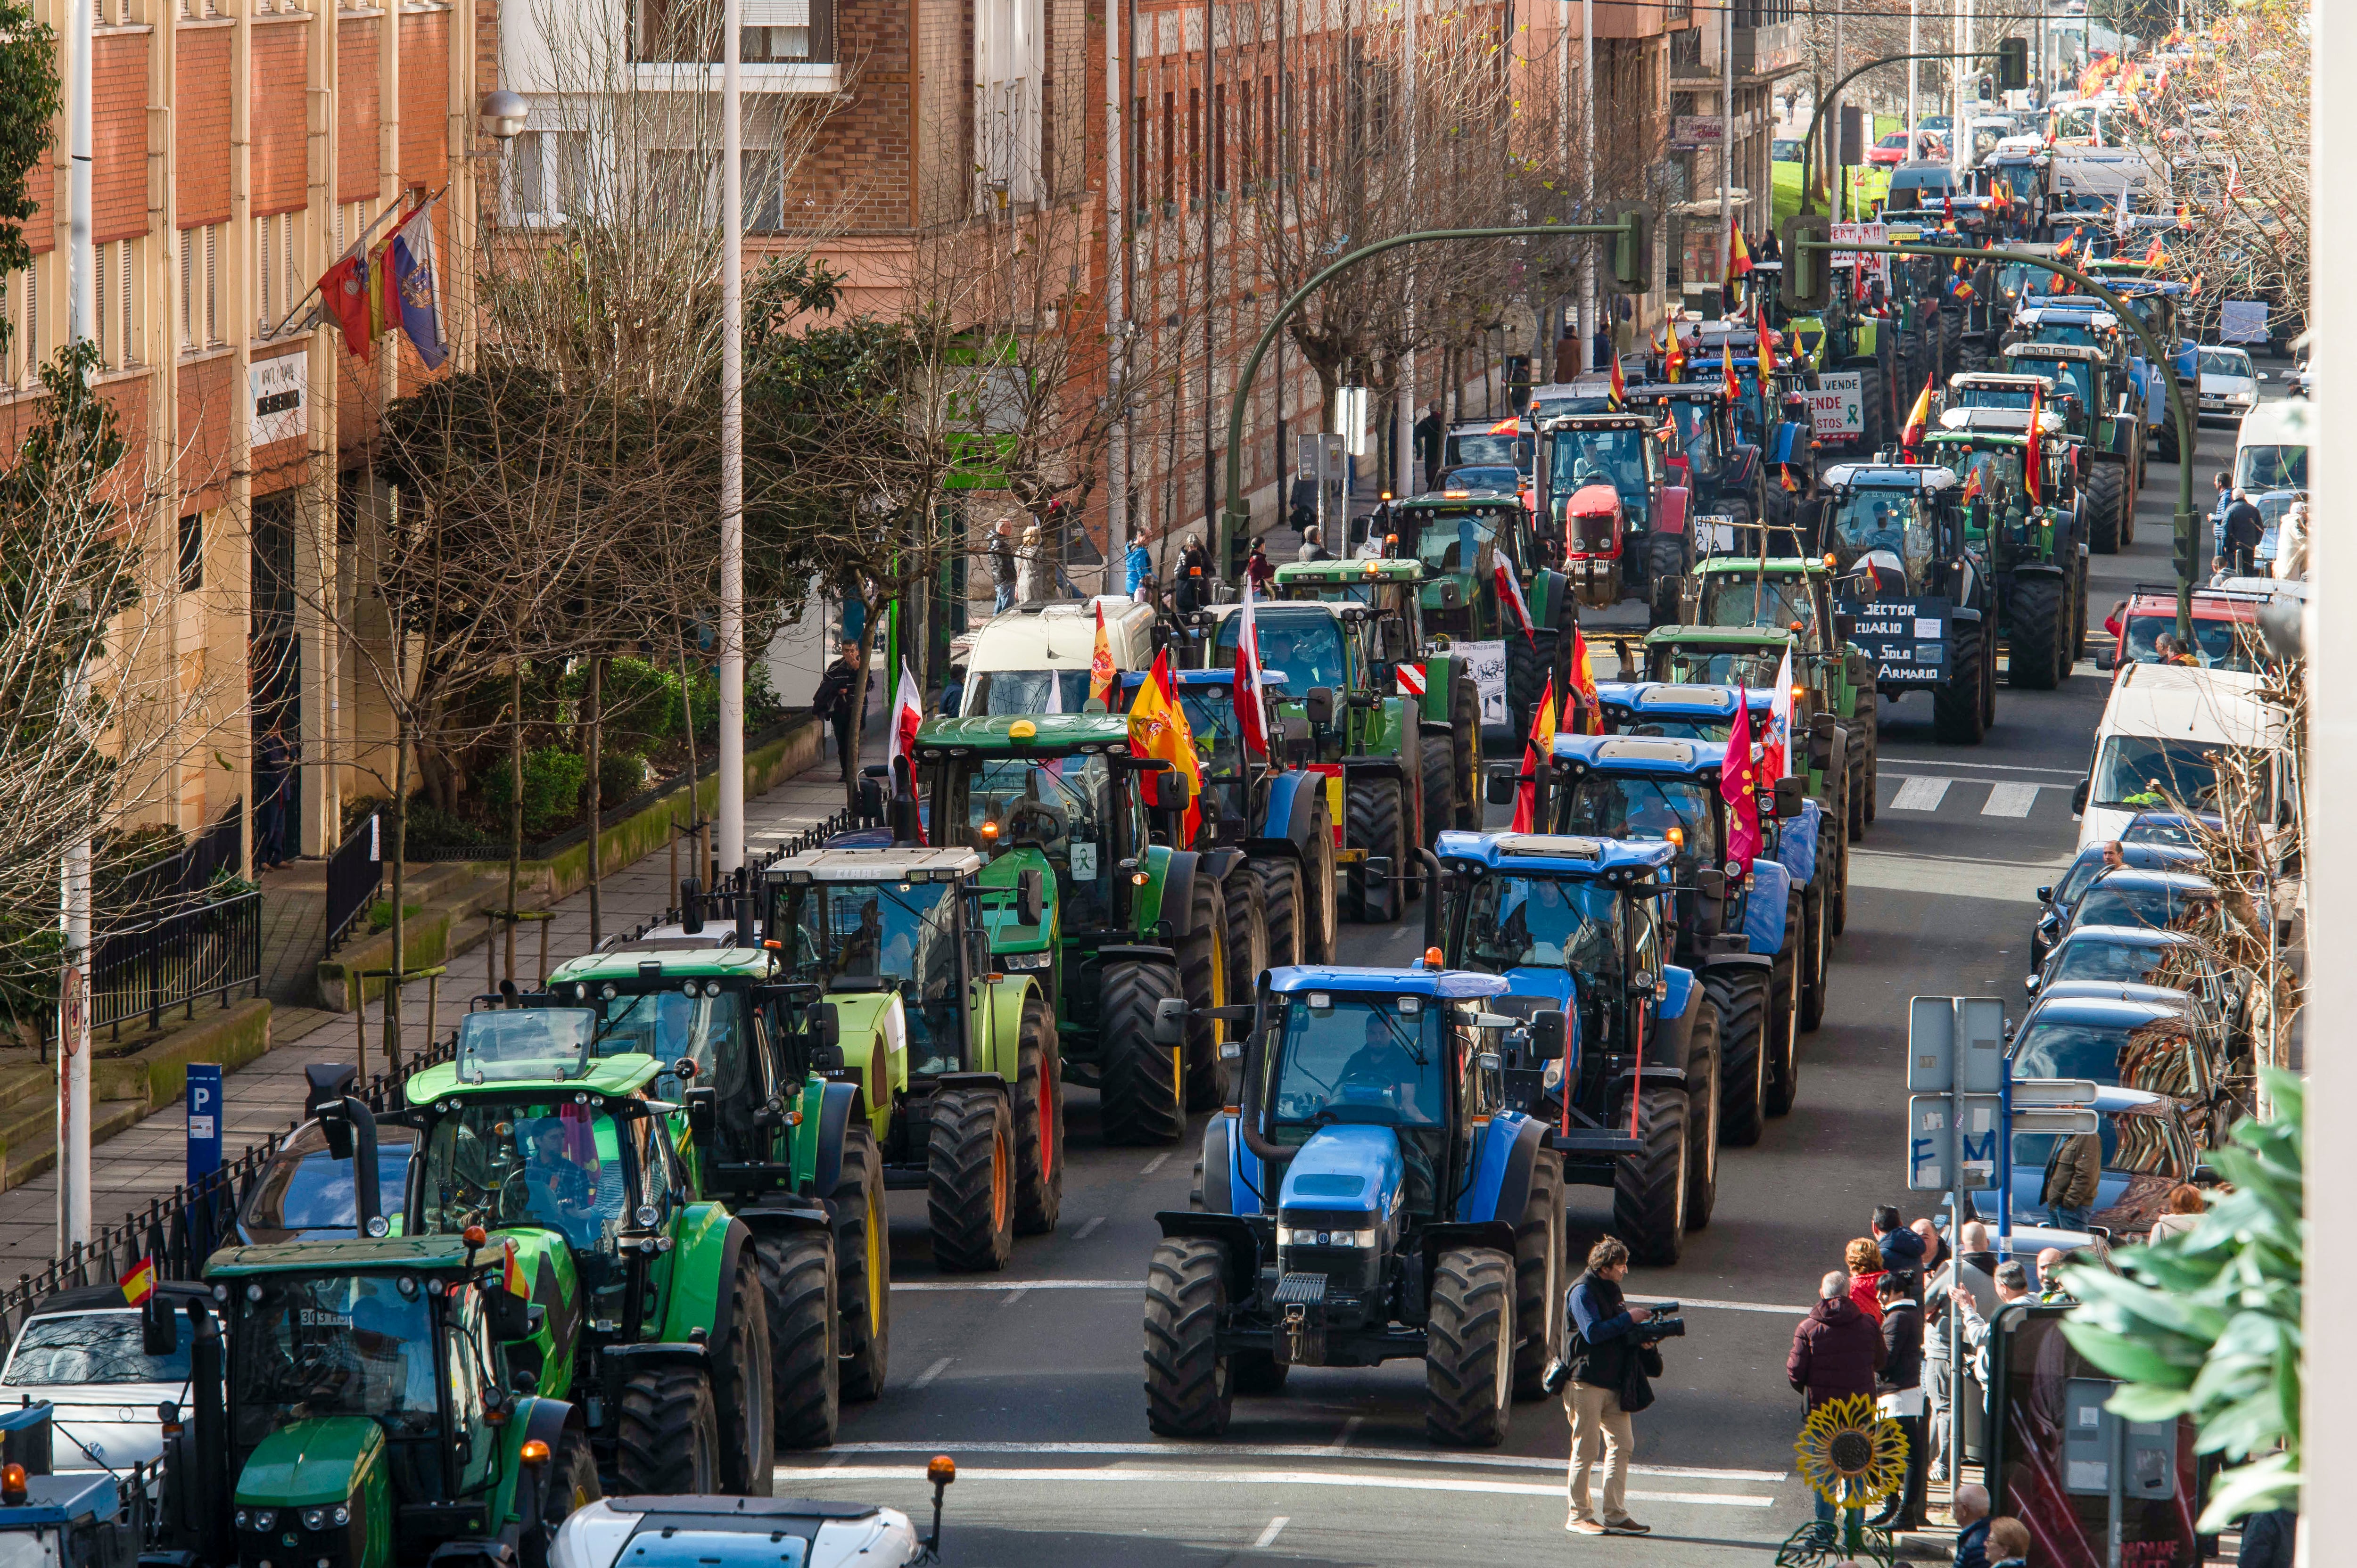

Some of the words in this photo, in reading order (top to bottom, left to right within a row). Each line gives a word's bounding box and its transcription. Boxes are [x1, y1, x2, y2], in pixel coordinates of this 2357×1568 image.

[1824, 379, 1858, 390] VENDE
[835, 869, 882, 878] CLAAS
[194, 1088, 210, 1111] P
